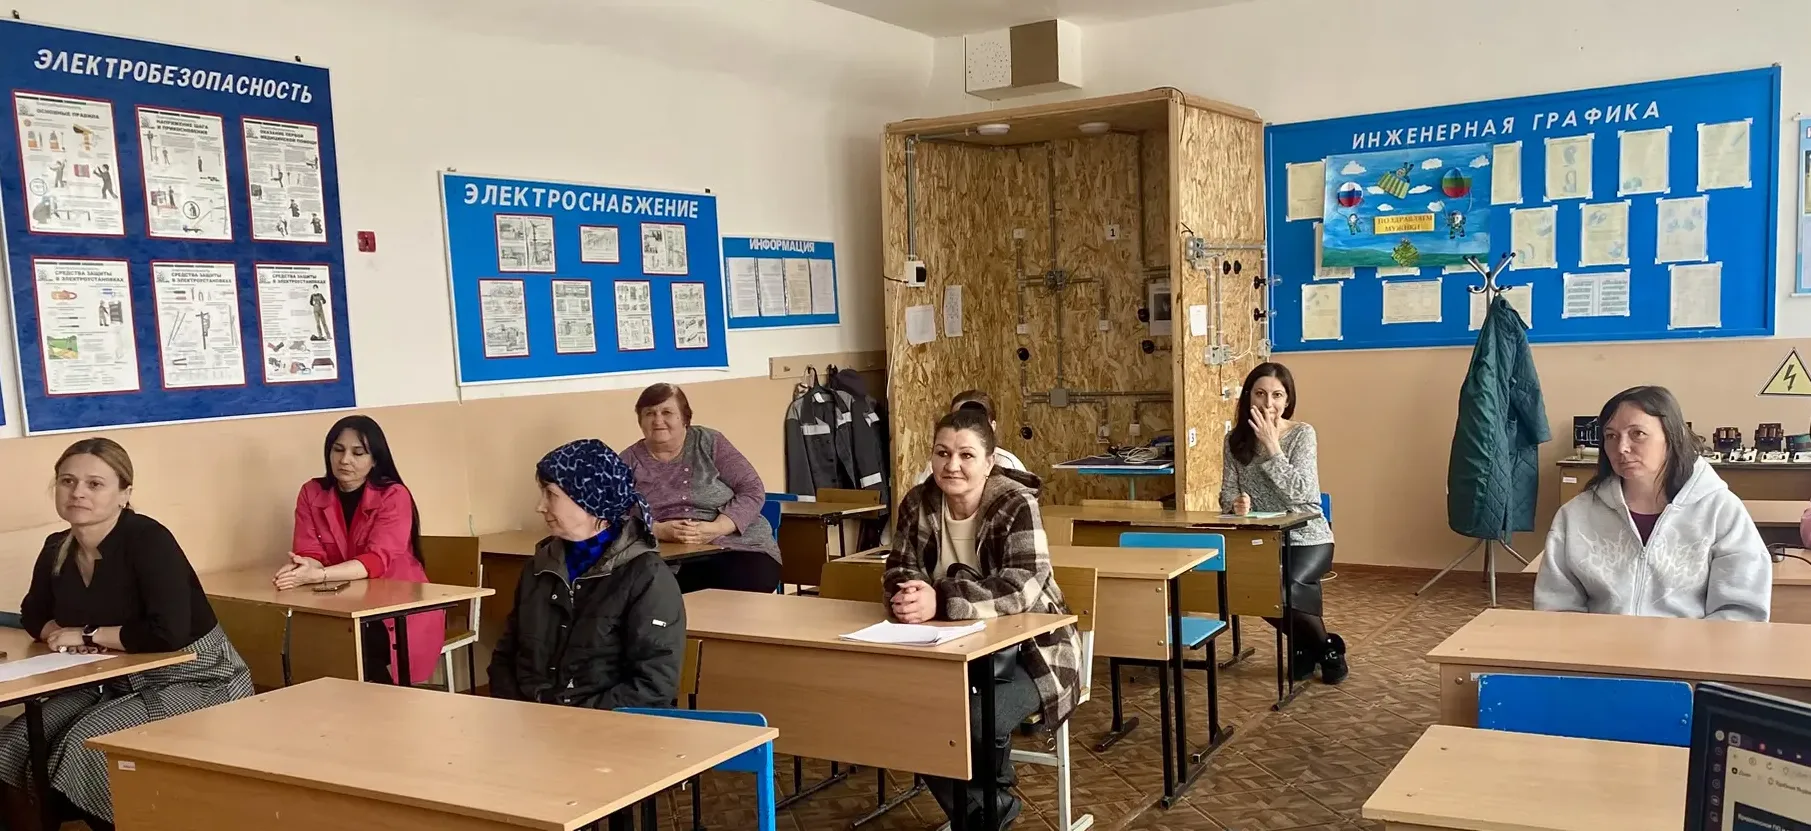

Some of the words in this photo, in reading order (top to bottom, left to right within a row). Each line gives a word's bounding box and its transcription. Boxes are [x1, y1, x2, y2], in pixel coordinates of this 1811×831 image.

[34, 47, 313, 104] ЭЛЕКТРОБЕЗОПАСНОСТЬ
[36, 108, 71, 117] ОСНОВНЫЕ
[156, 119, 193, 127] НАПРЯЖЕНИЕ
[1351, 116, 1515, 150] ИНЖЕНЕРНАЯ
[1532, 101, 1660, 131] ГРАФИКА
[162, 125, 208, 135] ПРИКОСНОВЕНИЯ
[260, 135, 295, 143] МЕДИЦИНСКОЙ
[464, 182, 699, 219] ЭЛЕКТРОСНАБЖЕНИЕ
[1377, 214, 1432, 224] ПОЗДРАВЛЯЕМ
[1110, 228, 1115, 237] 1
[749, 238, 815, 254] ИНФОРМАЦИЯ
